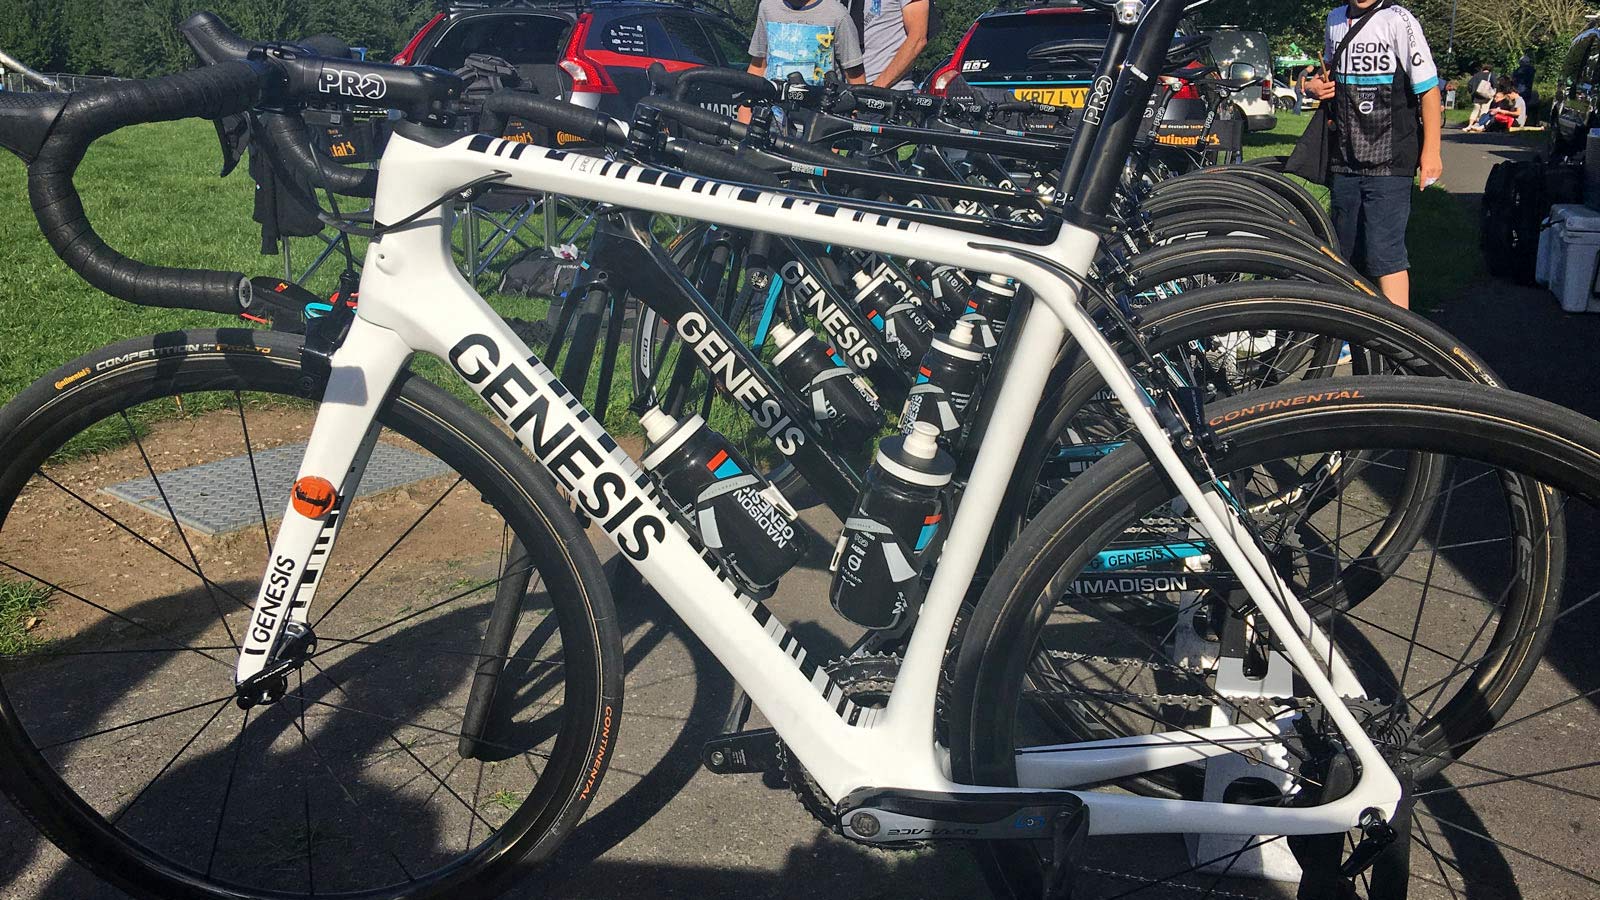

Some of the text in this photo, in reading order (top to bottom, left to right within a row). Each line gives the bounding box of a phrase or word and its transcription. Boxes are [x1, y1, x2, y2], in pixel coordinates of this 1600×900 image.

[1351, 55, 1391, 72] ESIS
[1352, 42, 1390, 54] ISON
[319, 68, 386, 99] PRO
[1083, 75, 1113, 125] PRO
[780, 260, 878, 369] GENESIS
[54, 368, 88, 390] Continental
[96, 344, 200, 372] COMPETITION
[676, 311, 805, 456] GENESIS
[902, 394, 923, 436] ENESIS
[1208, 388, 1365, 427] CONTINENTAL
[449, 333, 666, 561] GENESIS
[732, 489, 787, 549] MADISON
[1108, 549, 1164, 567] GENESIS
[252, 554, 295, 644] GENESIS
[1084, 576, 1188, 594] MADISON
[579, 706, 613, 802] CONTINENTAL
